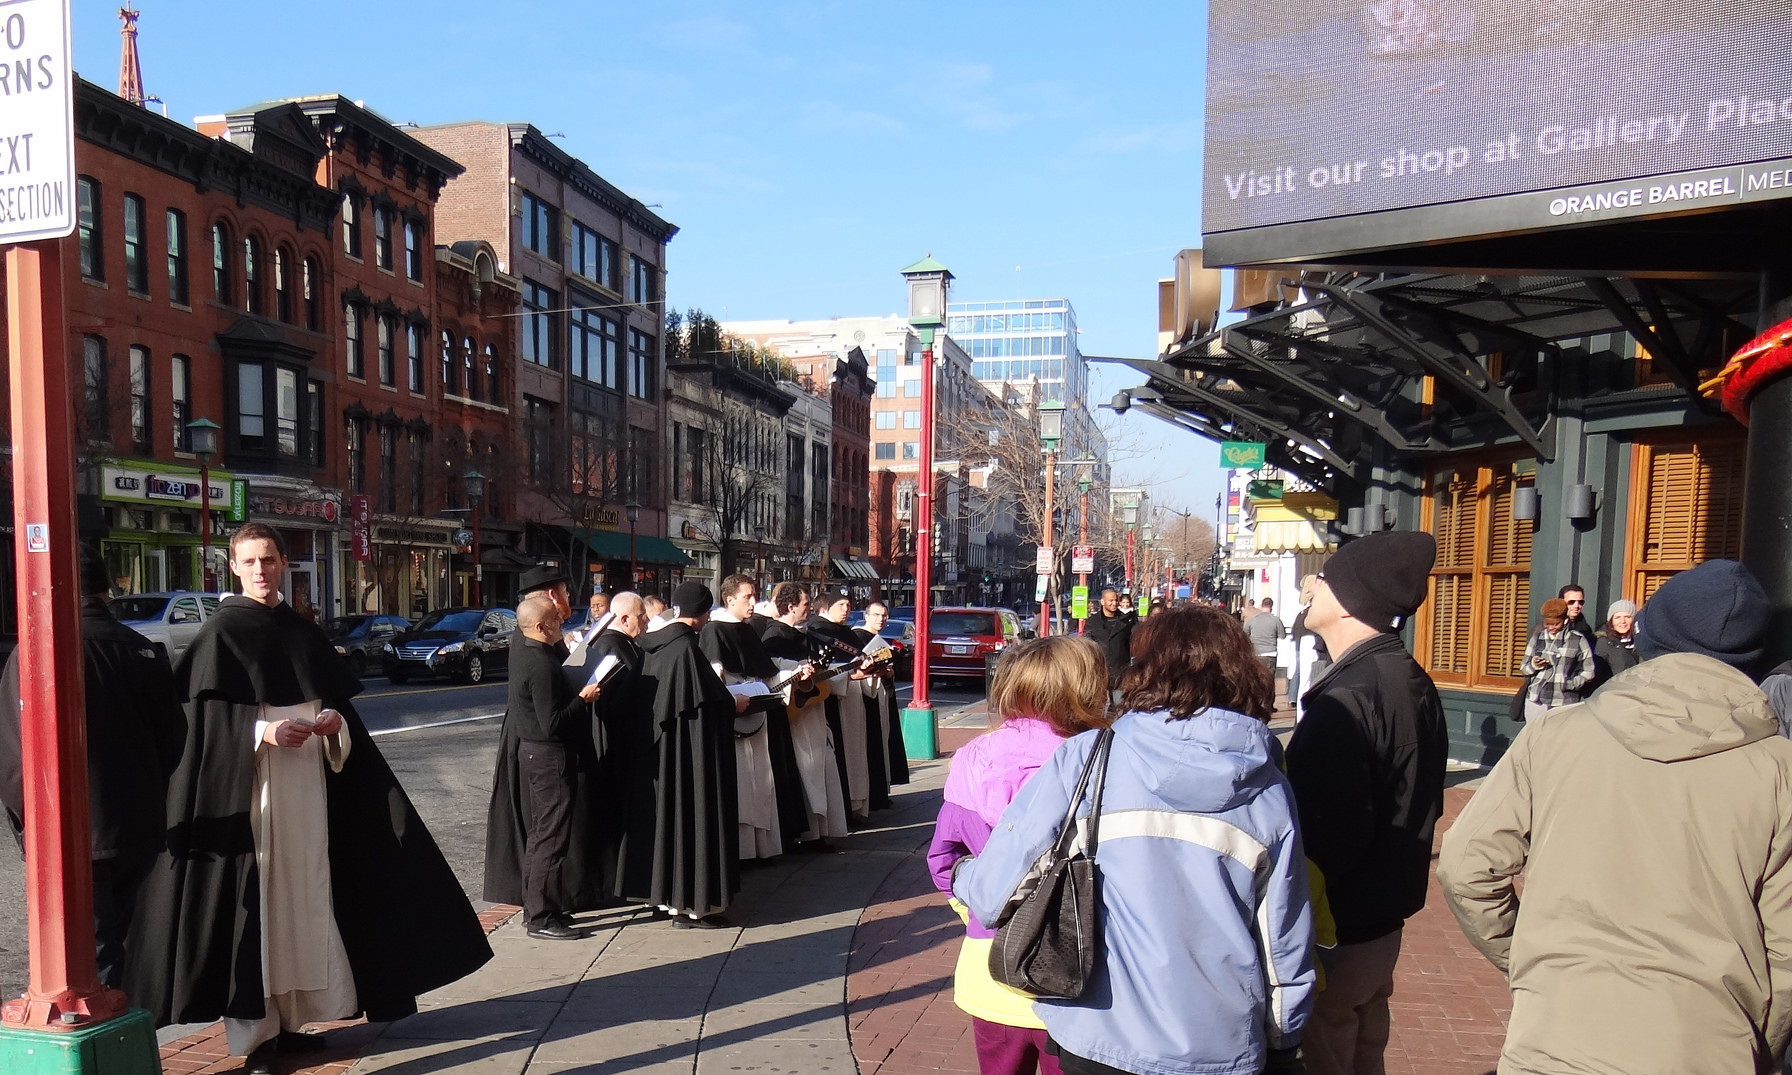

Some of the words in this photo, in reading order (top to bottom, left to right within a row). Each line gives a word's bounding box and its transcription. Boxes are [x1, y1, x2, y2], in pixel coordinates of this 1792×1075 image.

[1224, 165, 1297, 200] Visit
[1308, 159, 1368, 188] our
[1380, 146, 1470, 179] shop
[1484, 132, 1520, 162] at
[1537, 111, 1689, 155] Gallery
[1549, 188, 1643, 217] ORANGE
[1649, 176, 1736, 204] BARREL
